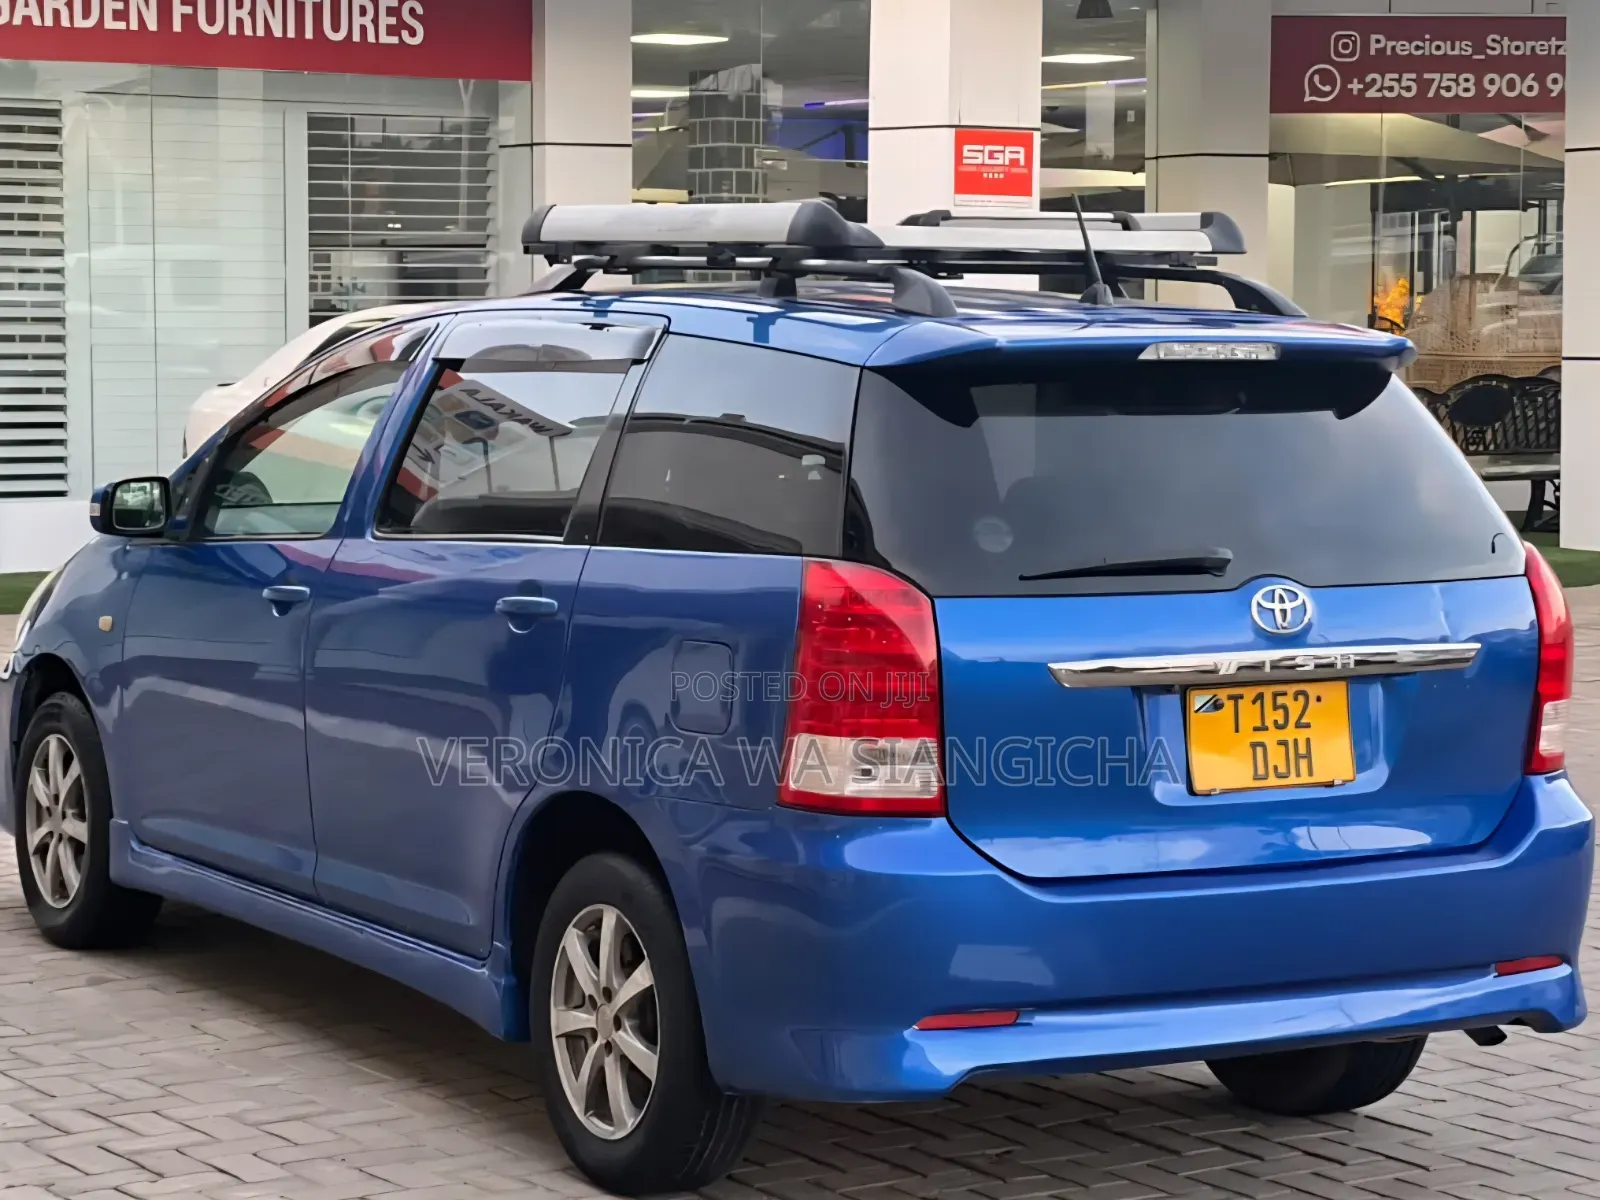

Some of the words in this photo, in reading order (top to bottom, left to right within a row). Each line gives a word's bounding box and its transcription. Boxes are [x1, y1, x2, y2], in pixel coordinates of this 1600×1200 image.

[0, 0, 158, 31] ARDEN
[172, 0, 424, 46] FURNITURES
[1348, 73, 1417, 98] +255
[1423, 73, 1475, 98] 758
[1483, 73, 1539, 98] 906
[1546, 72, 1566, 97] 9
[962, 145, 1025, 166] SGA
[1249, 738, 1314, 781] DJH
